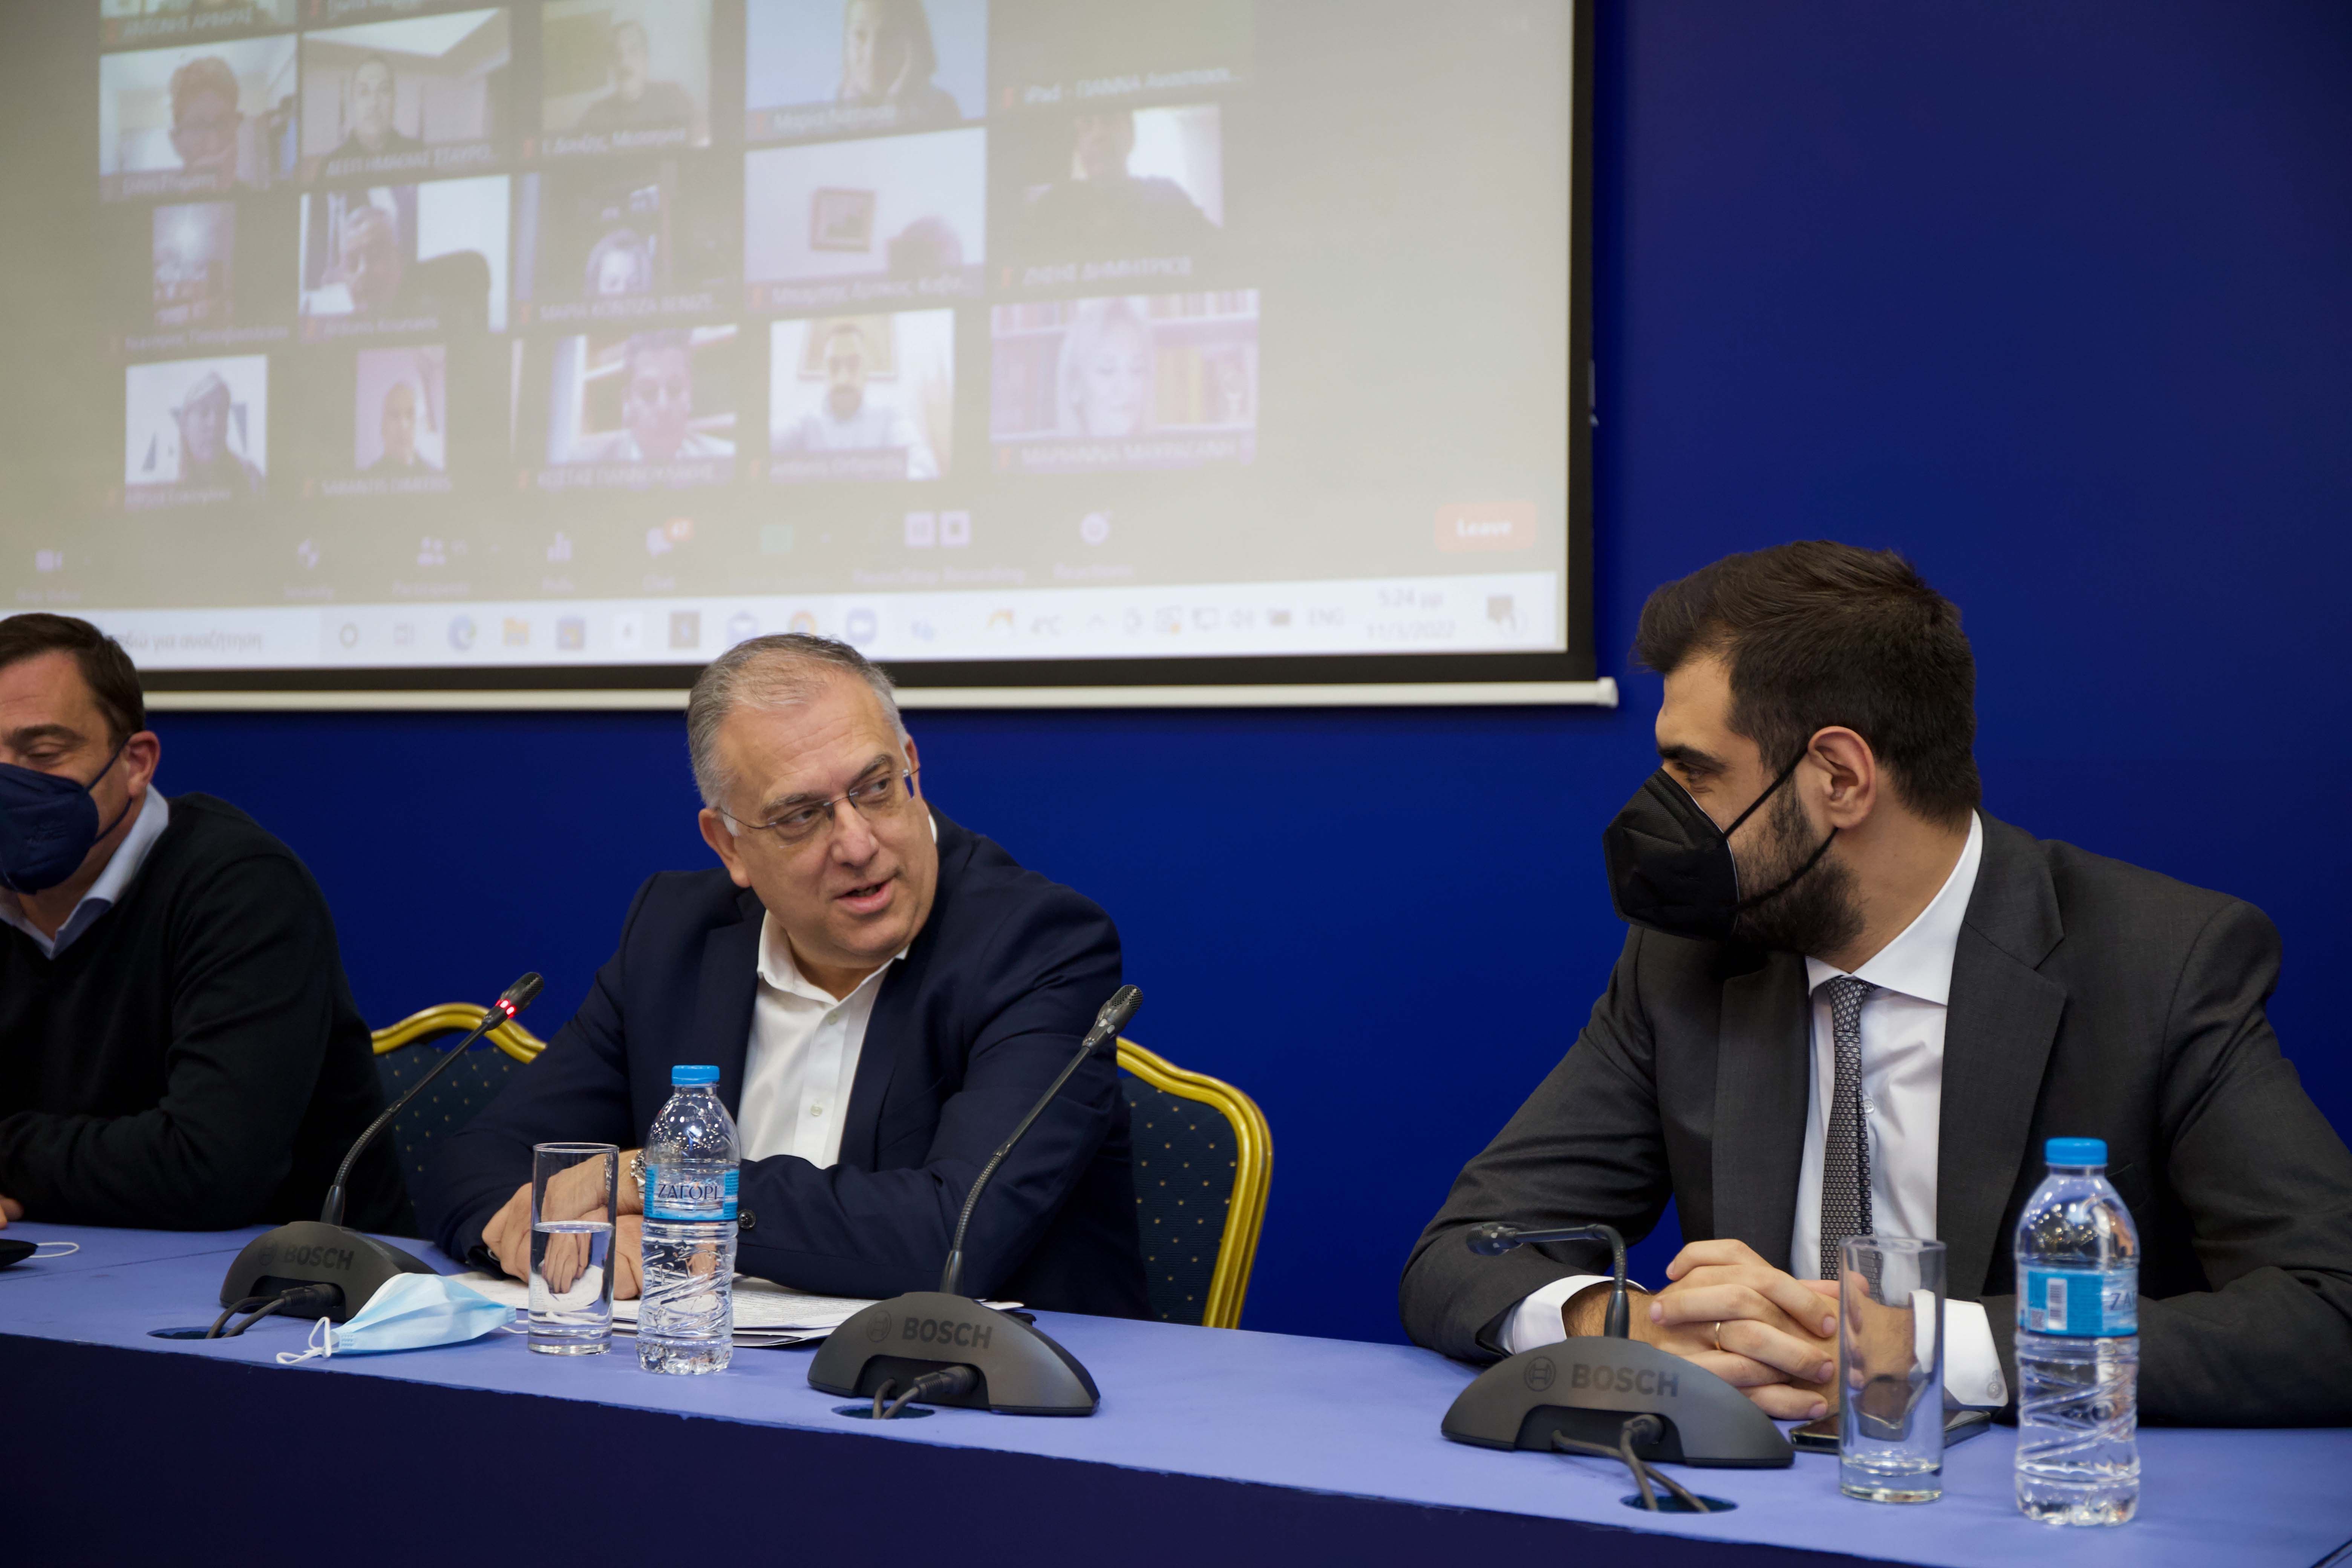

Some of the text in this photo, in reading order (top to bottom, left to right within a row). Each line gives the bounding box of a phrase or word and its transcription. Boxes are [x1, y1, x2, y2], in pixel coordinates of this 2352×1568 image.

[1456, 518, 1512, 537] Leave
[1308, 608, 1344, 626] ENG
[285, 1245, 355, 1270] BOSCH
[902, 1317, 993, 1349] BOSCH
[1571, 1363, 1679, 1397] BOSCH
